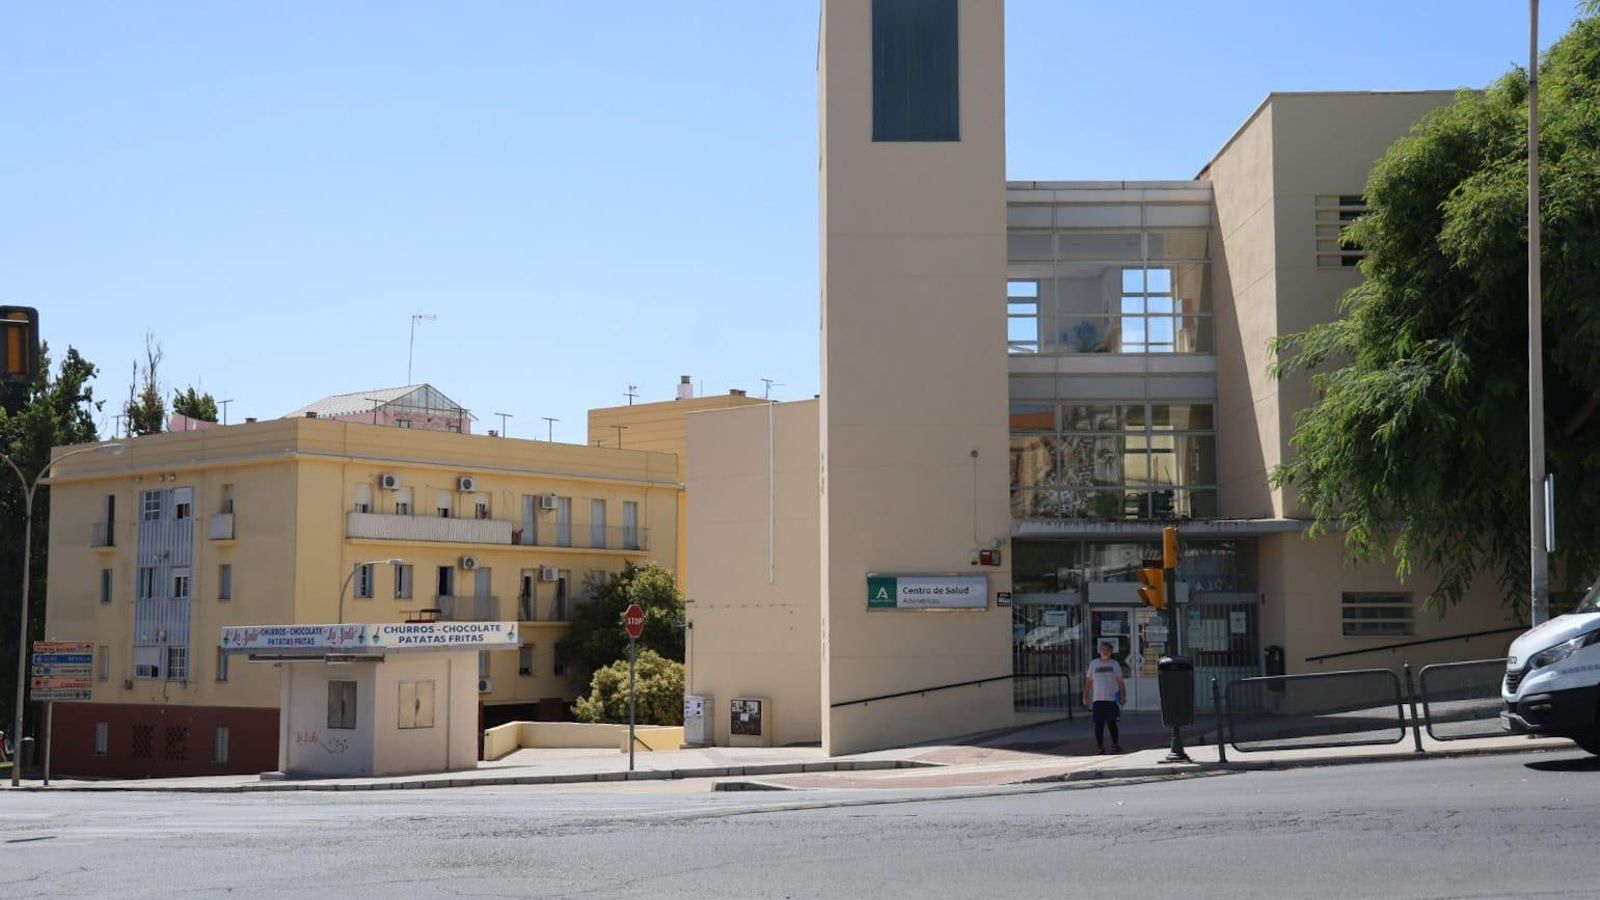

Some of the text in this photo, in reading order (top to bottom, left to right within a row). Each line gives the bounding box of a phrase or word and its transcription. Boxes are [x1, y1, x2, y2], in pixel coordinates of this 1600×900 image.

[902, 586, 970, 595] Centro de Salud
[627, 617, 643, 625] STOP
[261, 627, 286, 636] CHURROS
[290, 626, 322, 635] CHOCOLATE
[384, 625, 435, 634] CHURROS
[442, 624, 502, 633] CHOCOLATE
[267, 636, 315, 646] PATATAS FRITAS
[398, 634, 485, 644] PATATAS FRITAS
